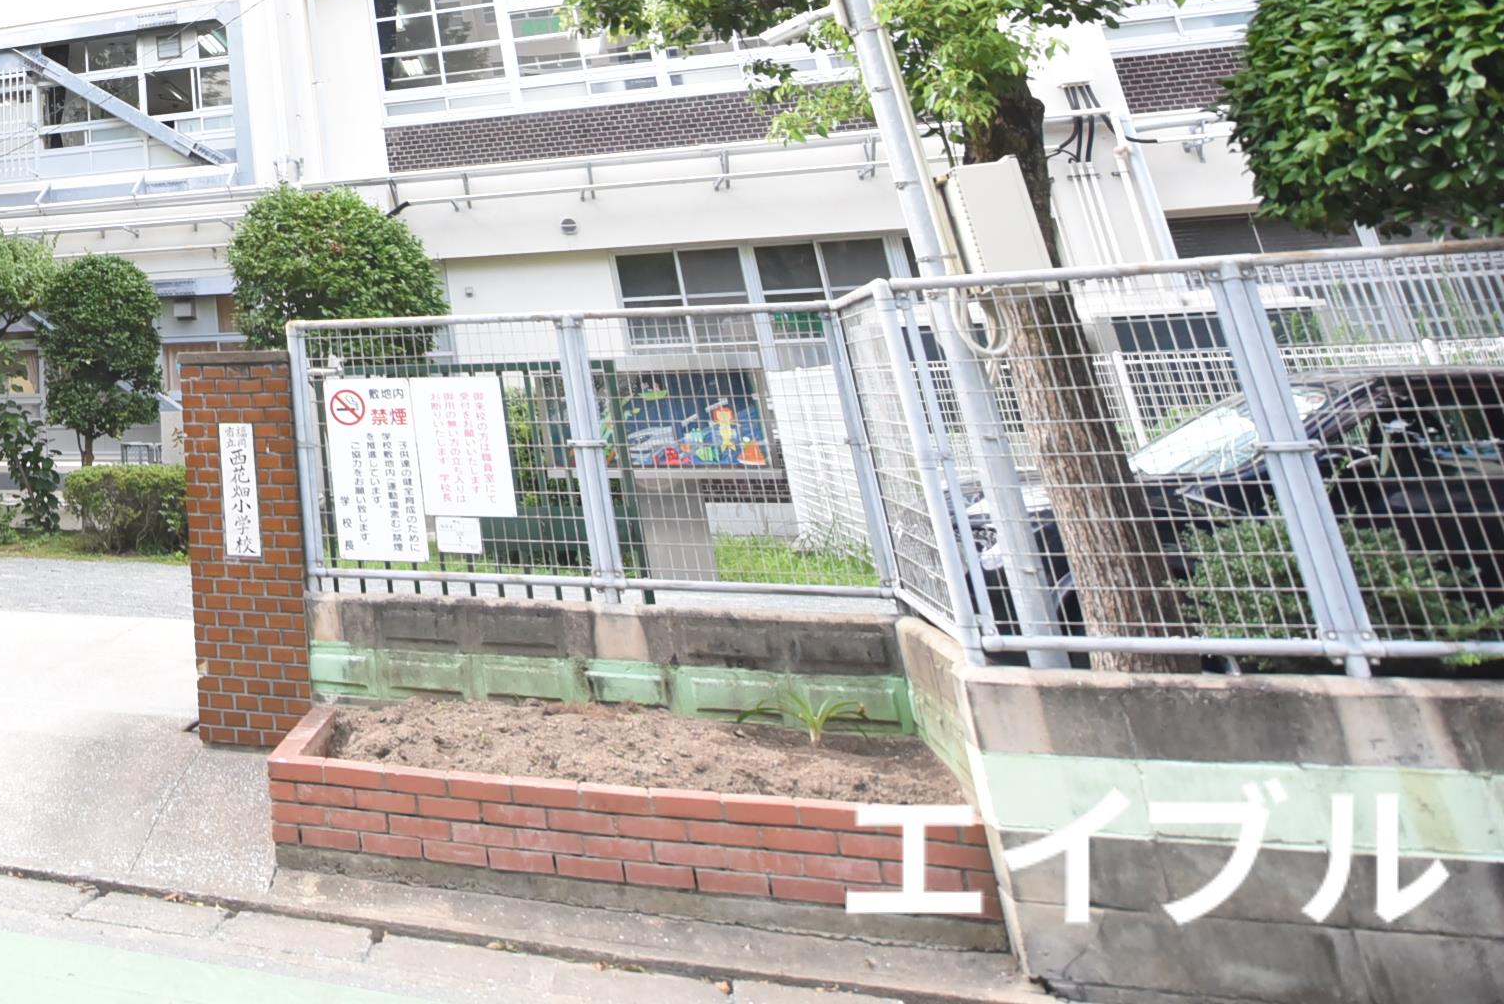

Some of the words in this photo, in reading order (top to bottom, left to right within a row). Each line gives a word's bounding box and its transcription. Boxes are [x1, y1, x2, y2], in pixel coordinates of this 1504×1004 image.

[368, 388, 405, 400] 敷地内
[370, 407, 408, 426] 禁煙
[229, 449, 256, 555] 西花畑小学校
[339, 495, 355, 551] 学校長
